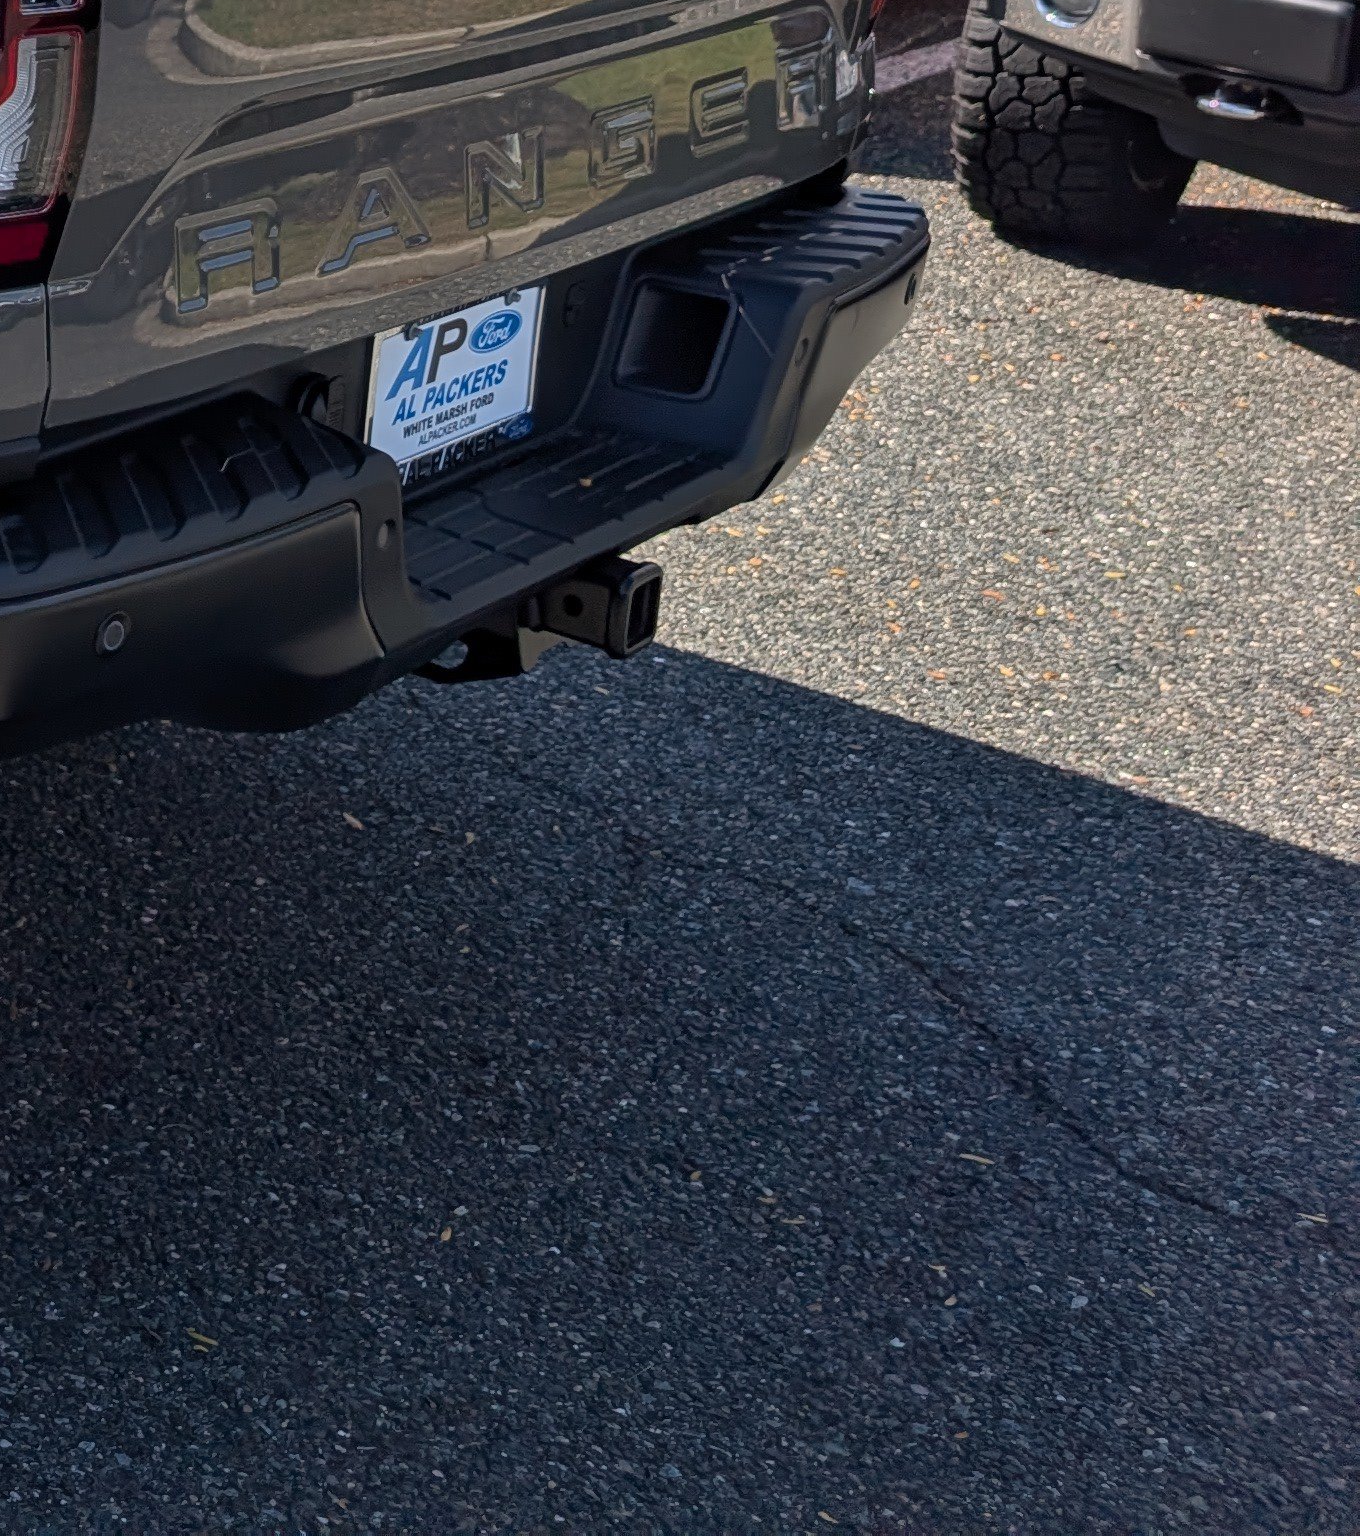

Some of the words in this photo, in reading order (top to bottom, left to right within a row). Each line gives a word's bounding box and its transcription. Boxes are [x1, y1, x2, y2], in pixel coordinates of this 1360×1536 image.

[174, 46, 825, 315] RANGER
[385, 317, 468, 402] AP
[391, 394, 417, 426] AL
[421, 358, 509, 414] PACKERS
[402, 415, 433, 439] WHITE
[434, 402, 468, 427] MARSH
[468, 391, 495, 413] FORD
